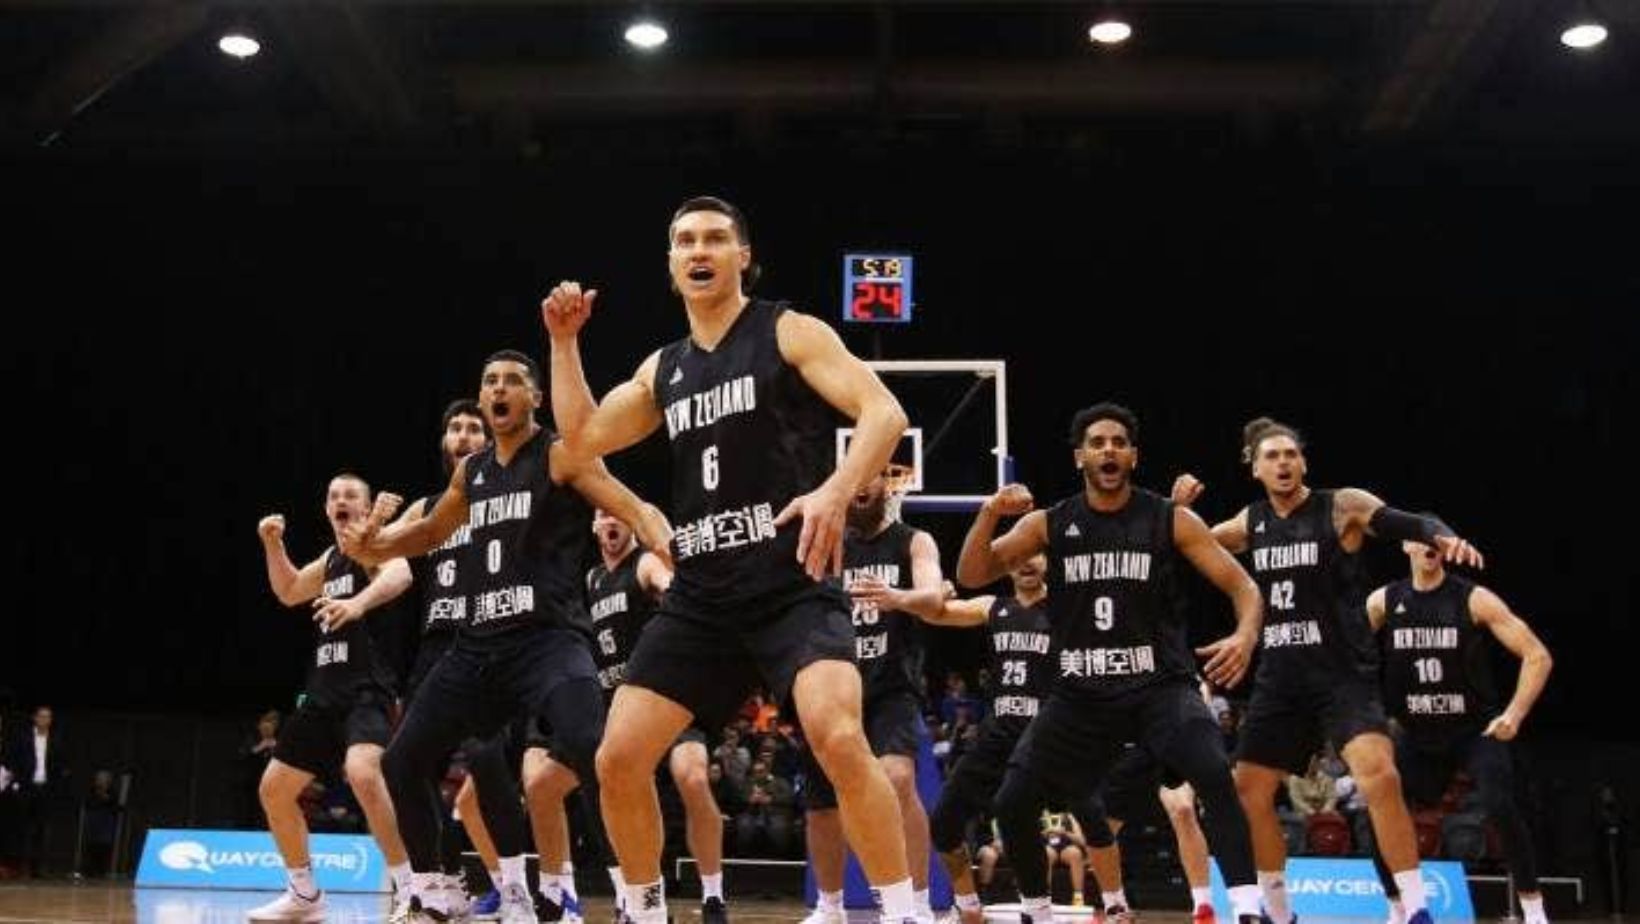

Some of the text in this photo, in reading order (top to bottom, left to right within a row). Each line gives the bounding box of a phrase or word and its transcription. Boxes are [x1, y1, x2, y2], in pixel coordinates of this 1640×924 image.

[853, 283, 903, 320] 24
[702, 444, 719, 491] 6
[675, 502, 777, 561] 美博空调
[487, 538, 501, 574] 0
[1064, 551, 1152, 584] NEW ZEALAND
[1270, 580, 1296, 611] 42
[1094, 596, 1114, 631] 9
[1002, 660, 1027, 687] 25
[1059, 645, 1156, 677] 美博空调
[1413, 657, 1443, 684] 10
[159, 840, 356, 874] QUAYCTRE
